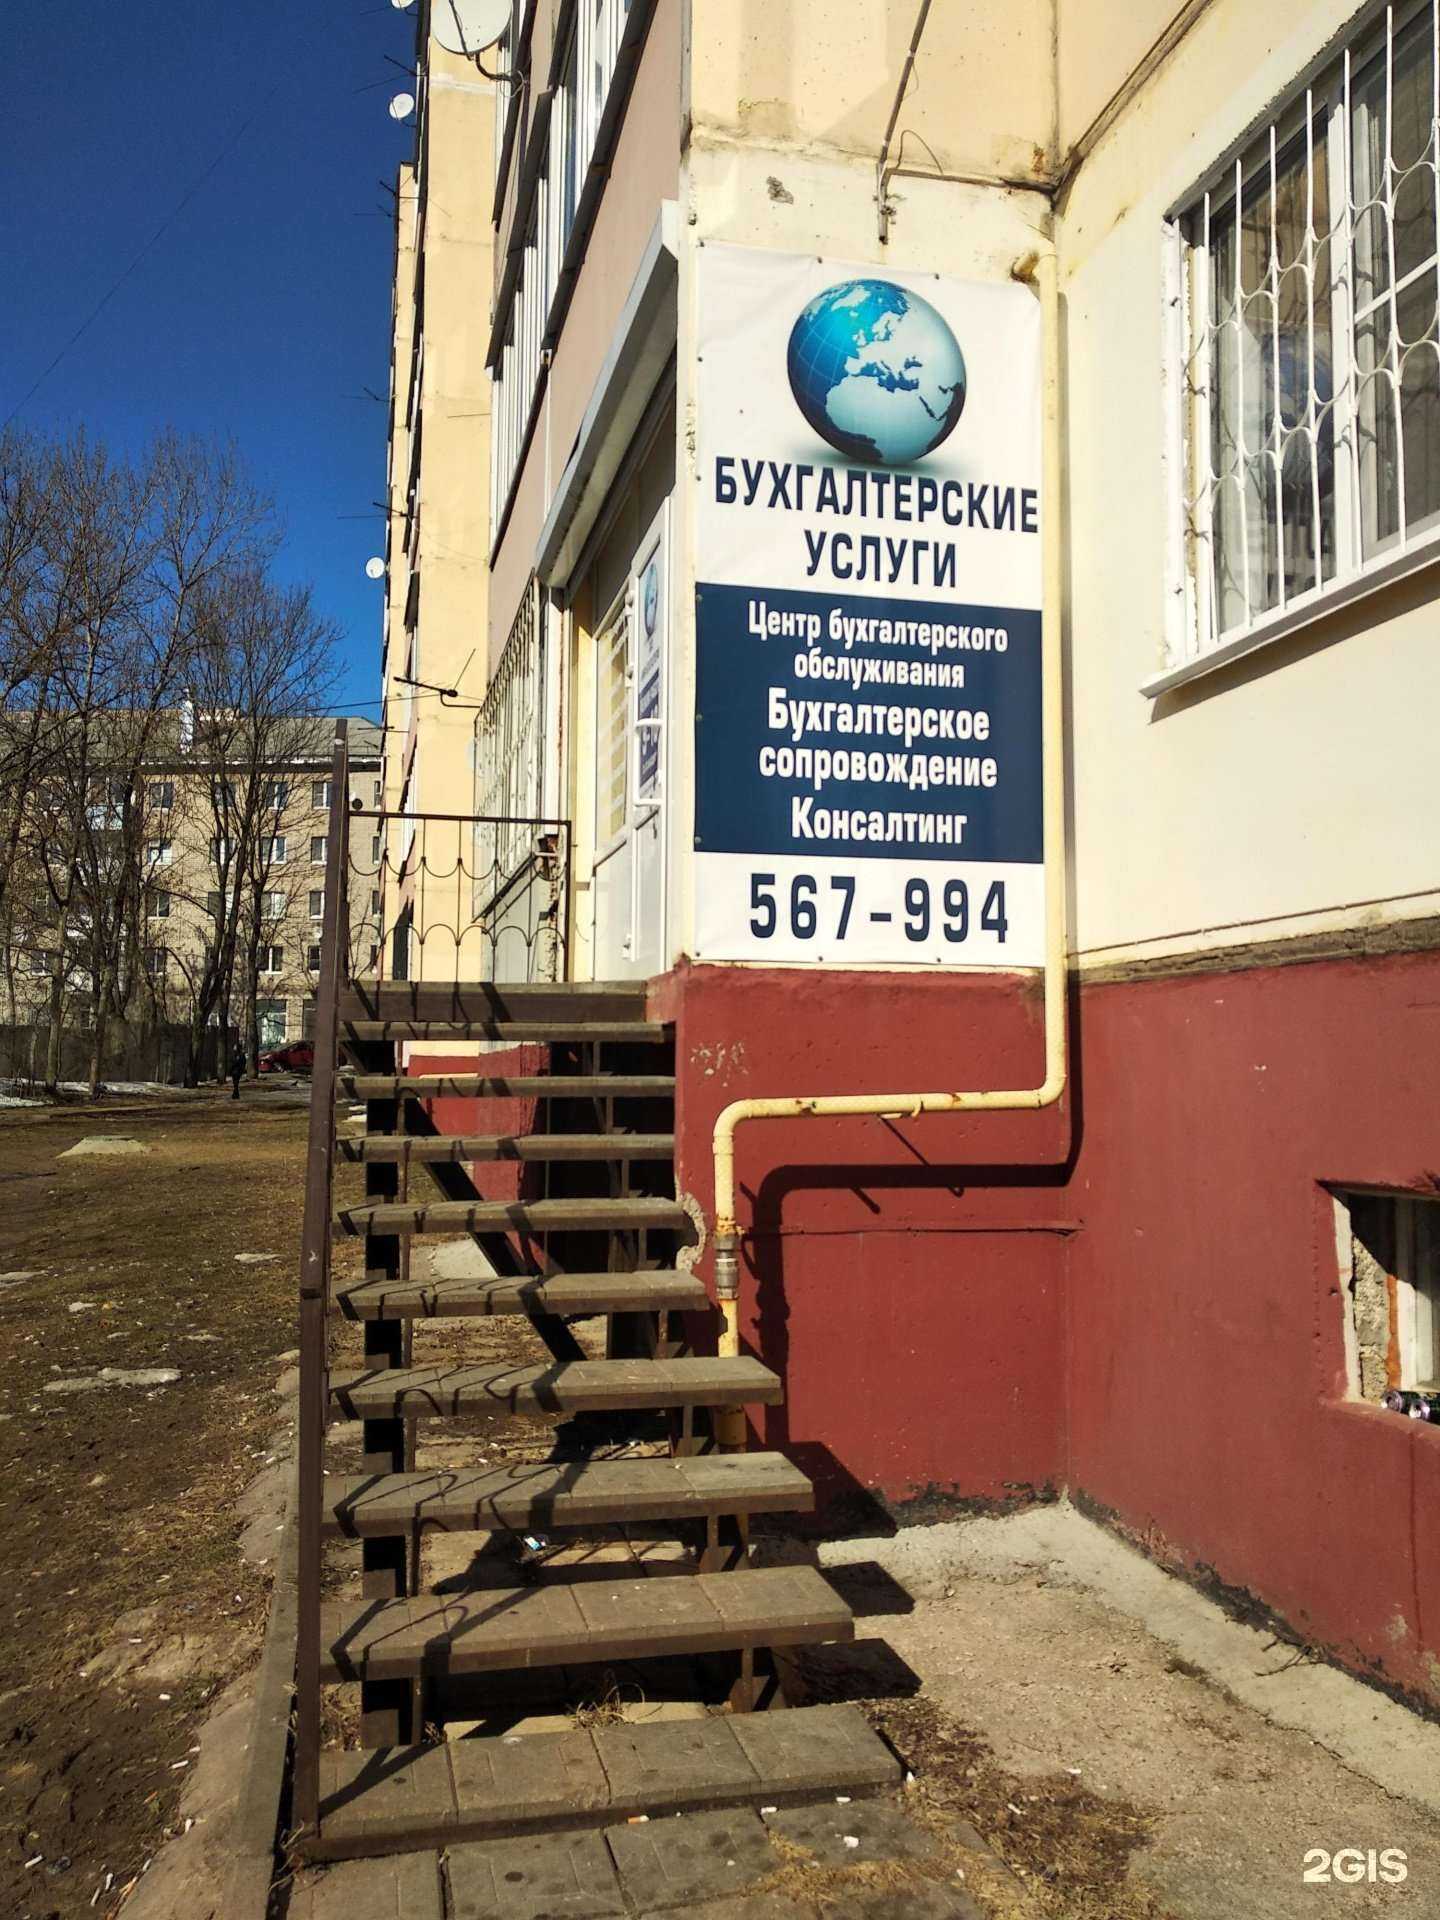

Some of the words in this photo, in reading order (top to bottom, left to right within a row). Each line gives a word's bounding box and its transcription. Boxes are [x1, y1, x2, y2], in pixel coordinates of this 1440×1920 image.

[715, 456, 1038, 534] БУХГАЛТЕРСКИЕ
[804, 529, 956, 588] УСЛУГИ
[747, 599, 821, 647] Центр
[828, 607, 1008, 656] бухгалтерского
[794, 646, 965, 691] обслуживания
[768, 686, 990, 748] Бухгалтерское
[758, 745, 998, 791] сопровождение
[791, 796, 968, 845] Консалтинг
[750, 872, 1008, 944] 567-994
